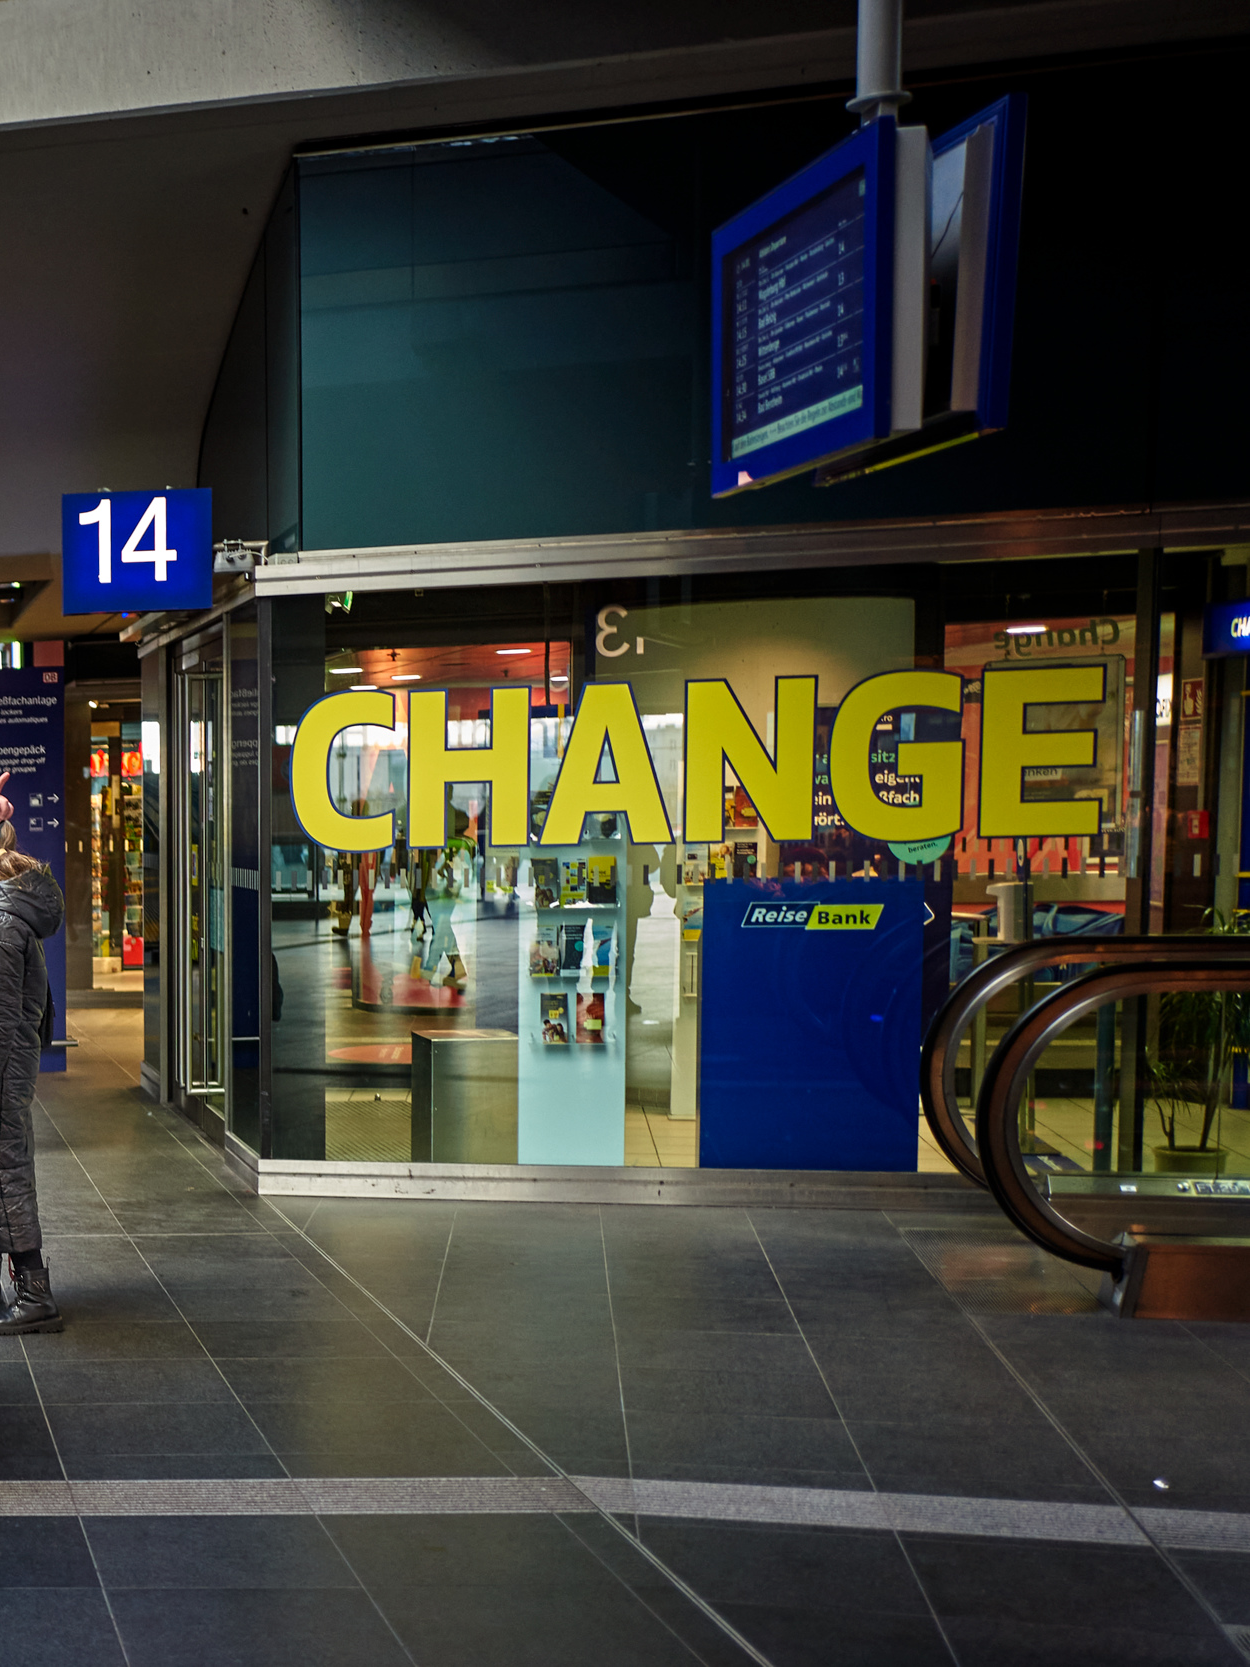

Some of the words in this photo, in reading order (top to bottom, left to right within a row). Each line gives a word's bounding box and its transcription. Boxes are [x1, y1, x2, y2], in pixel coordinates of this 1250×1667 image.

[78, 496, 178, 584] 14
[290, 661, 1105, 850] CHANGE
[751, 905, 808, 923] Reise
[818, 910, 871, 925] Bank
